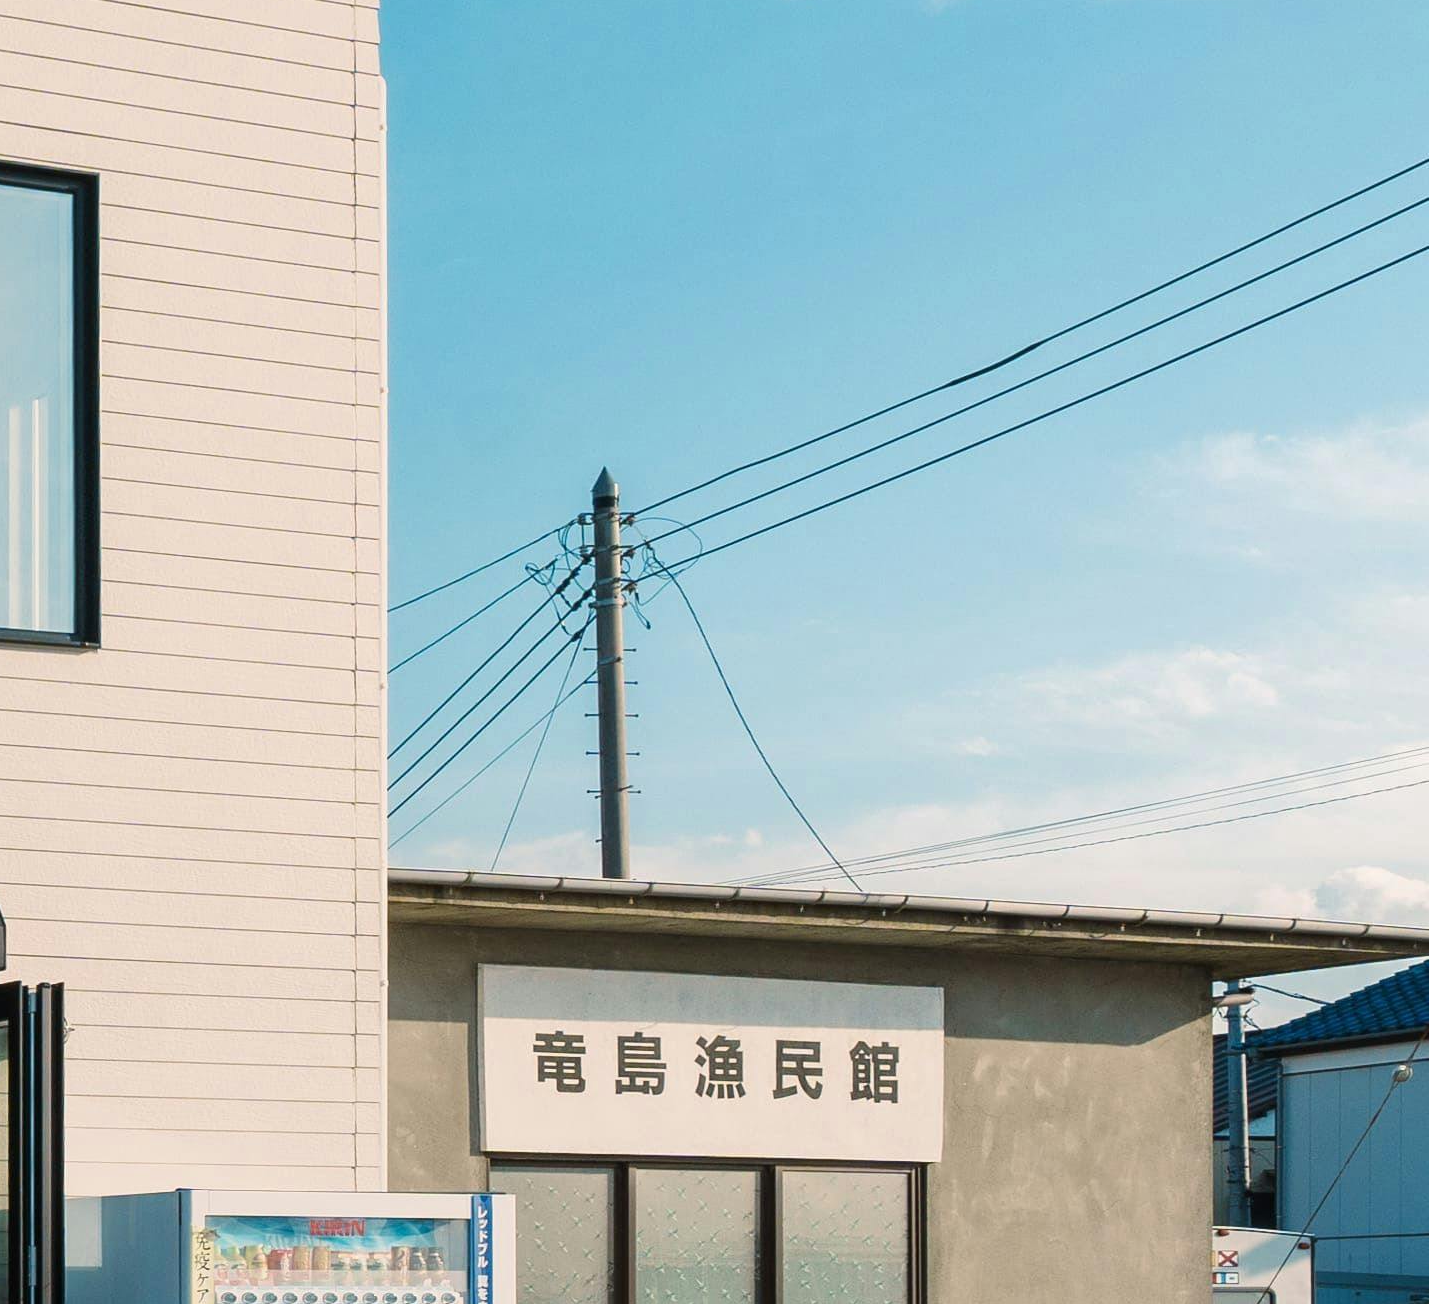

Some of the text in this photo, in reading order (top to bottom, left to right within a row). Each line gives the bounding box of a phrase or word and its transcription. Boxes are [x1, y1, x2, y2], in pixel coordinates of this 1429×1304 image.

[532, 1030, 900, 1104] 竜島漁民館
